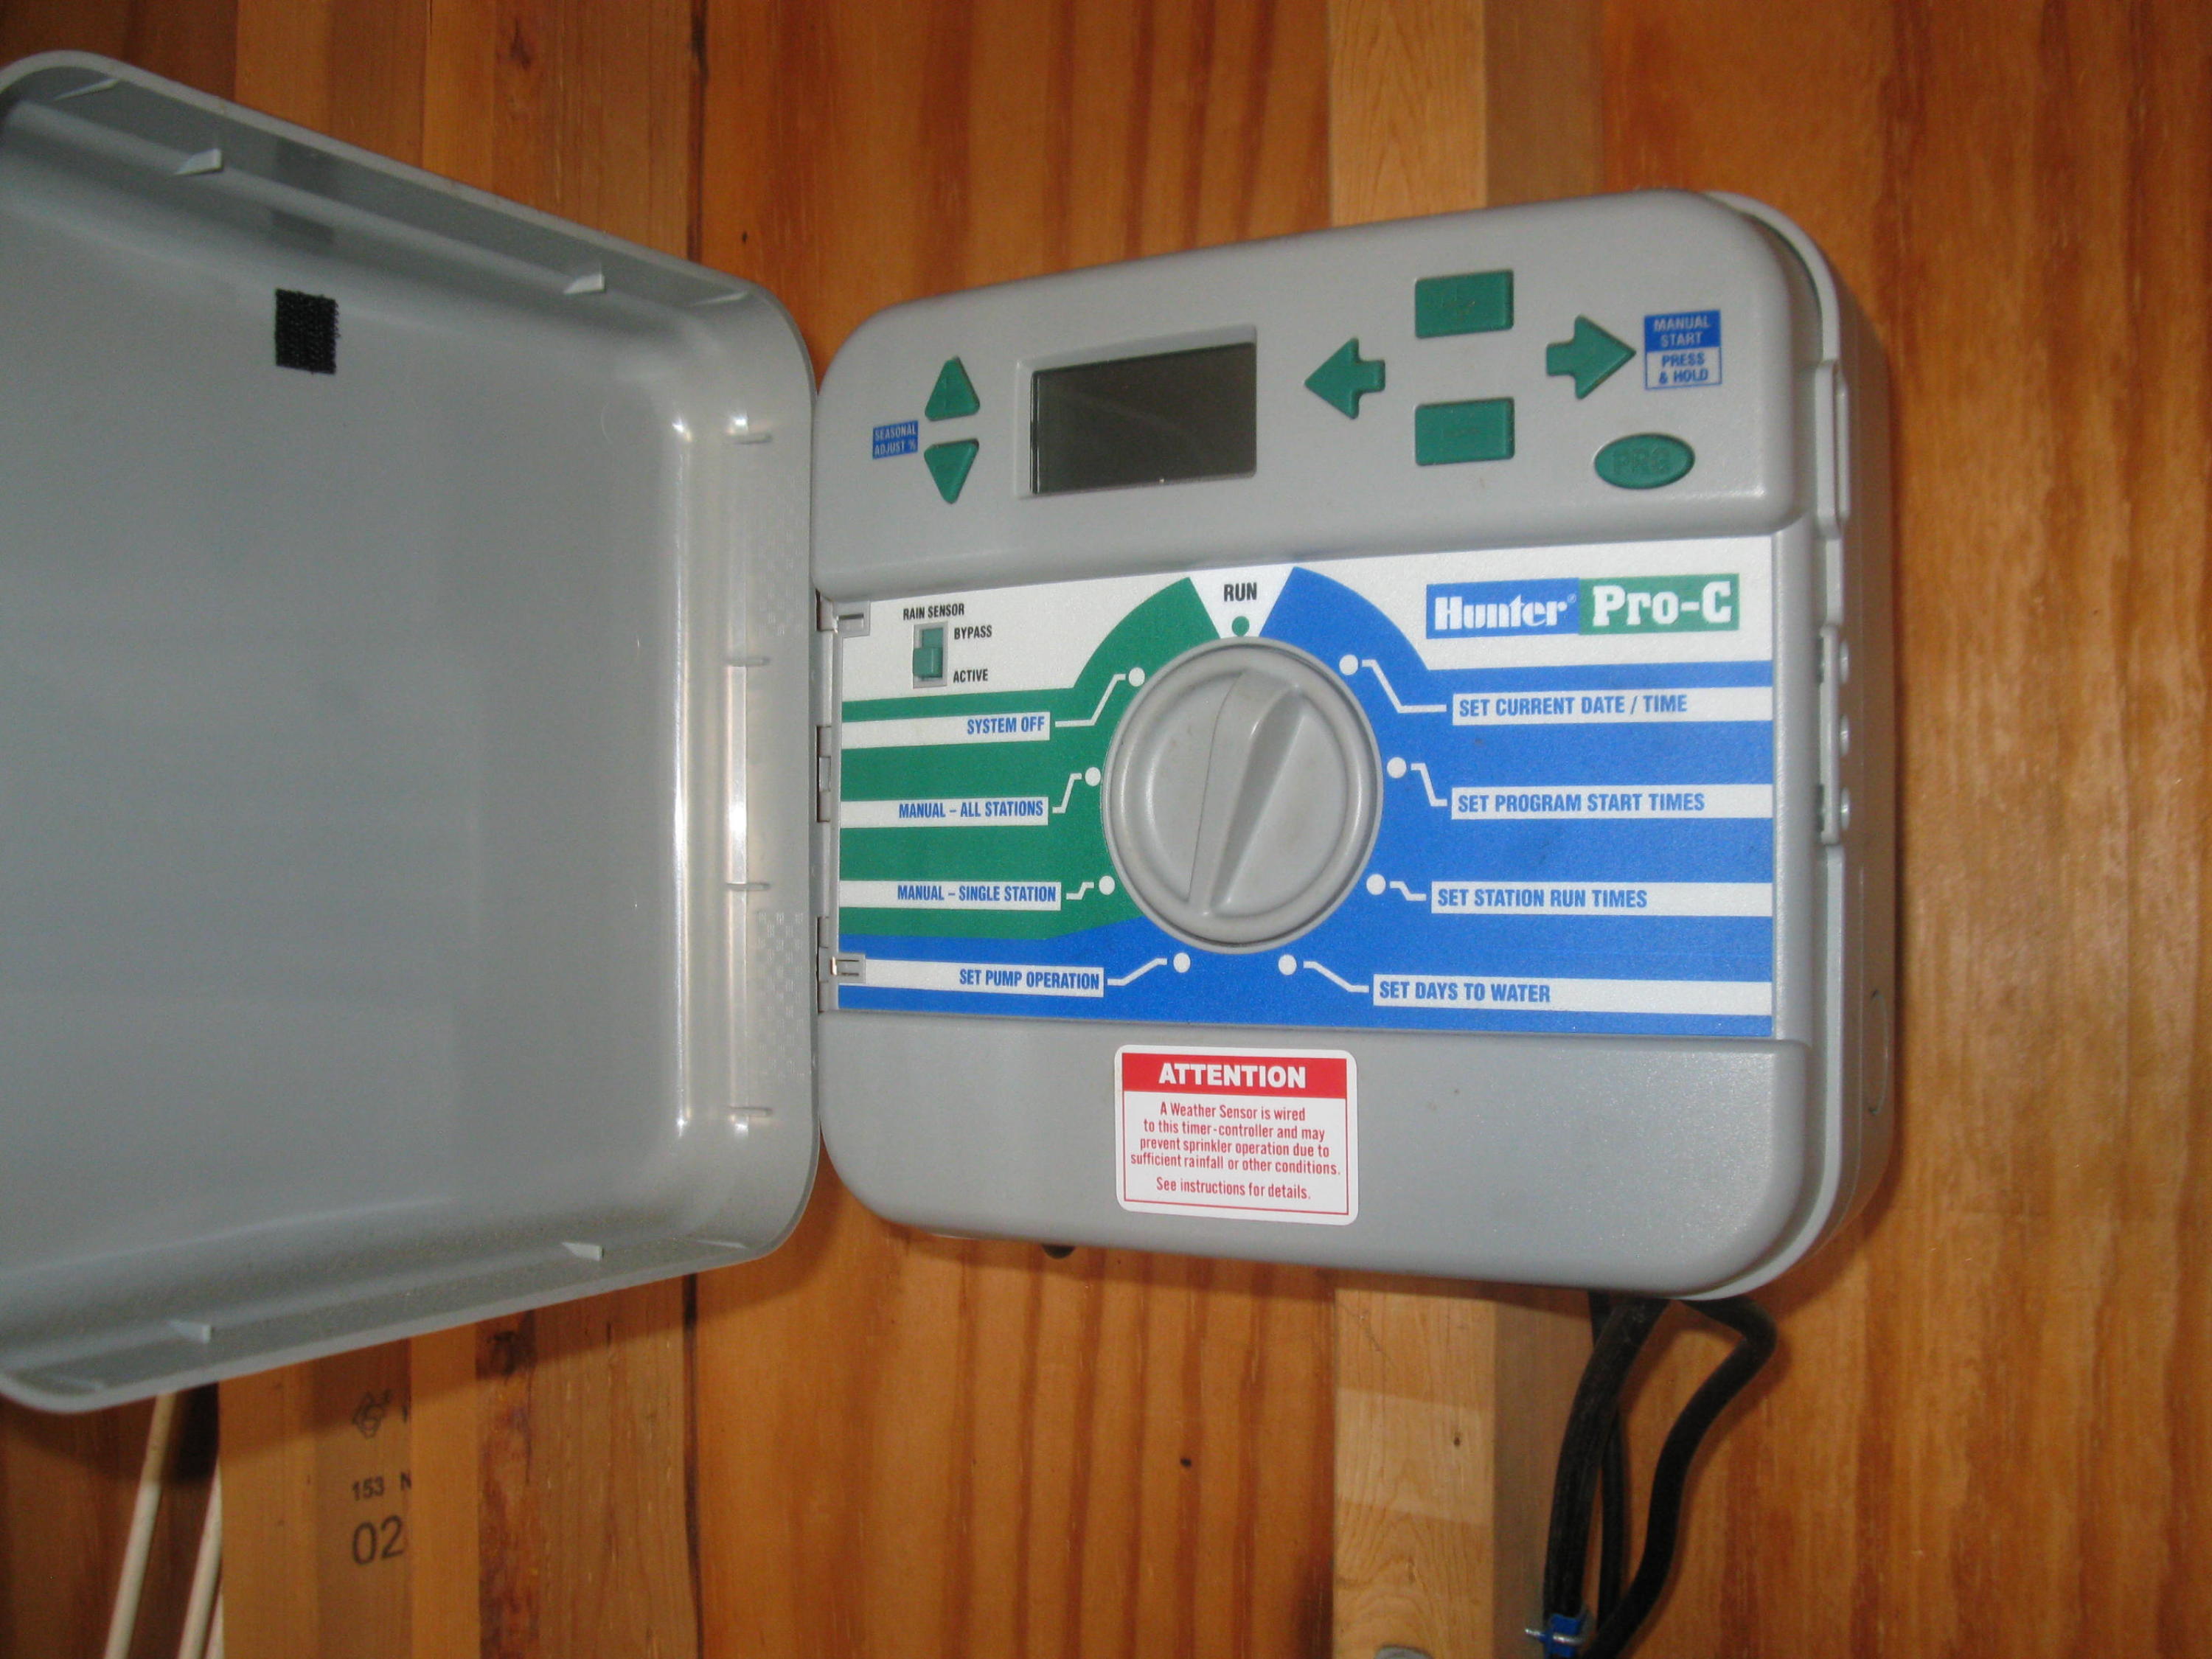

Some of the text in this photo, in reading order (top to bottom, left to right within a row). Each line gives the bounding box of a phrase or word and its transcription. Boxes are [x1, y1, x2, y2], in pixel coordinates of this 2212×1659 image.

[1654, 315, 1711, 331] MANUAL
[1660, 331, 1703, 347] START
[1662, 352, 1705, 367] PRESS
[1660, 369, 1708, 384] & HOLD
[874, 424, 916, 441] SEASONAL
[874, 439, 905, 454] ADJUST
[1224, 582, 1257, 602] RUN
[903, 603, 964, 620] RAIN SENSOR
[1593, 581, 1732, 627] Pro-C
[953, 625, 992, 640] BYPASS
[953, 669, 988, 683] ACTIVE
[1459, 698, 1490, 717] SET
[1495, 696, 1575, 716] CURRENT
[1581, 695, 1625, 714] DATE
[1642, 695, 1688, 713] TIME
[967, 716, 1045, 734] SYSTEM OFF
[899, 802, 946, 818] MANUAL
[960, 801, 981, 817] ALL
[985, 800, 1043, 817] STATIONS
[1458, 793, 1705, 813] SET PROGRAM START TIMES
[897, 885, 945, 901] MANUAL
[959, 885, 1000, 901] SINGLE
[1004, 886, 1057, 902] STATION
[1438, 888, 1647, 908] SET STATION RUN TIMES
[959, 969, 1099, 990] SET PUMP OPERATION
[1380, 981, 1551, 1003] SET DAYS TO WATER
[1159, 1062, 1306, 1088] ATTENTION
[1161, 1102, 1305, 1121] A Weather Sensor is wired
[1144, 1119, 1155, 1133] to
[1158, 1120, 1178, 1133] this
[1277, 1126, 1298, 1139] and
[1301, 1130, 1324, 1143] may
[1140, 1138, 1329, 1158] prevent sprinkler operation due to
[1130, 1153, 1340, 1175] sufficient rainfall or other conditions.
[1156, 1177, 1310, 1199] See instructions for details.
[352, 1476, 385, 1501] 153
[352, 1514, 405, 1565] 02
